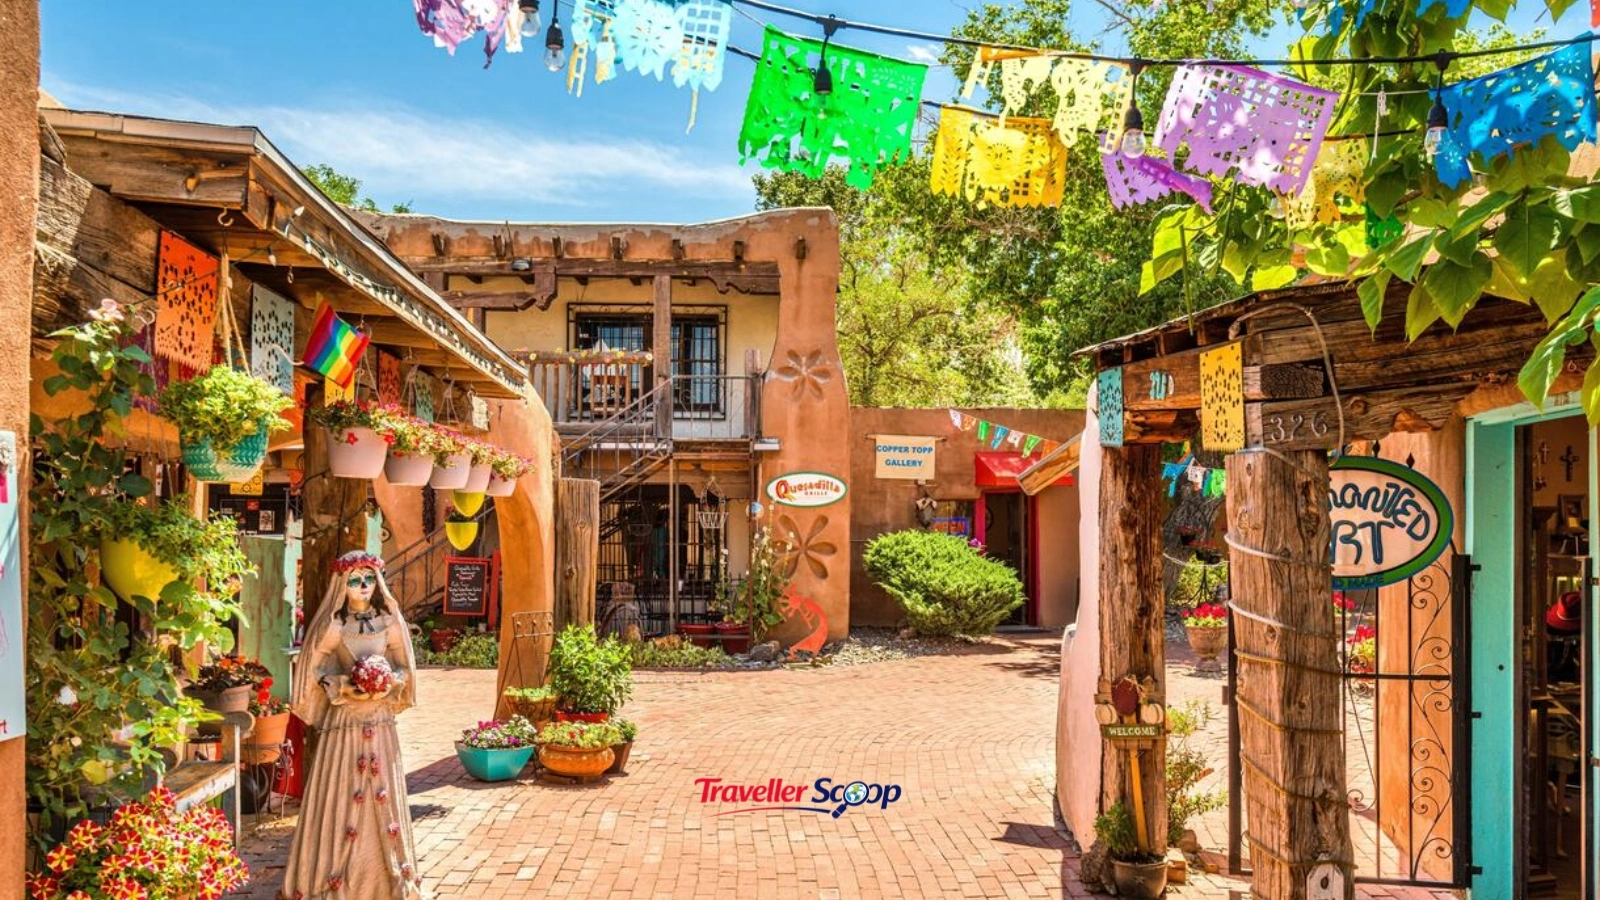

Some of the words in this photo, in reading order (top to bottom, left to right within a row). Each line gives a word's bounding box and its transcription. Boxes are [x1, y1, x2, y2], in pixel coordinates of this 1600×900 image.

[1270, 410, 1328, 443] 326
[876, 444, 909, 453] COPPER
[912, 446, 933, 454] TOPP
[885, 458, 923, 467] GALLERY
[775, 480, 840, 502] Quesadilla
[1329, 519, 1395, 565] RT
[1108, 726, 1155, 736] WELCOME
